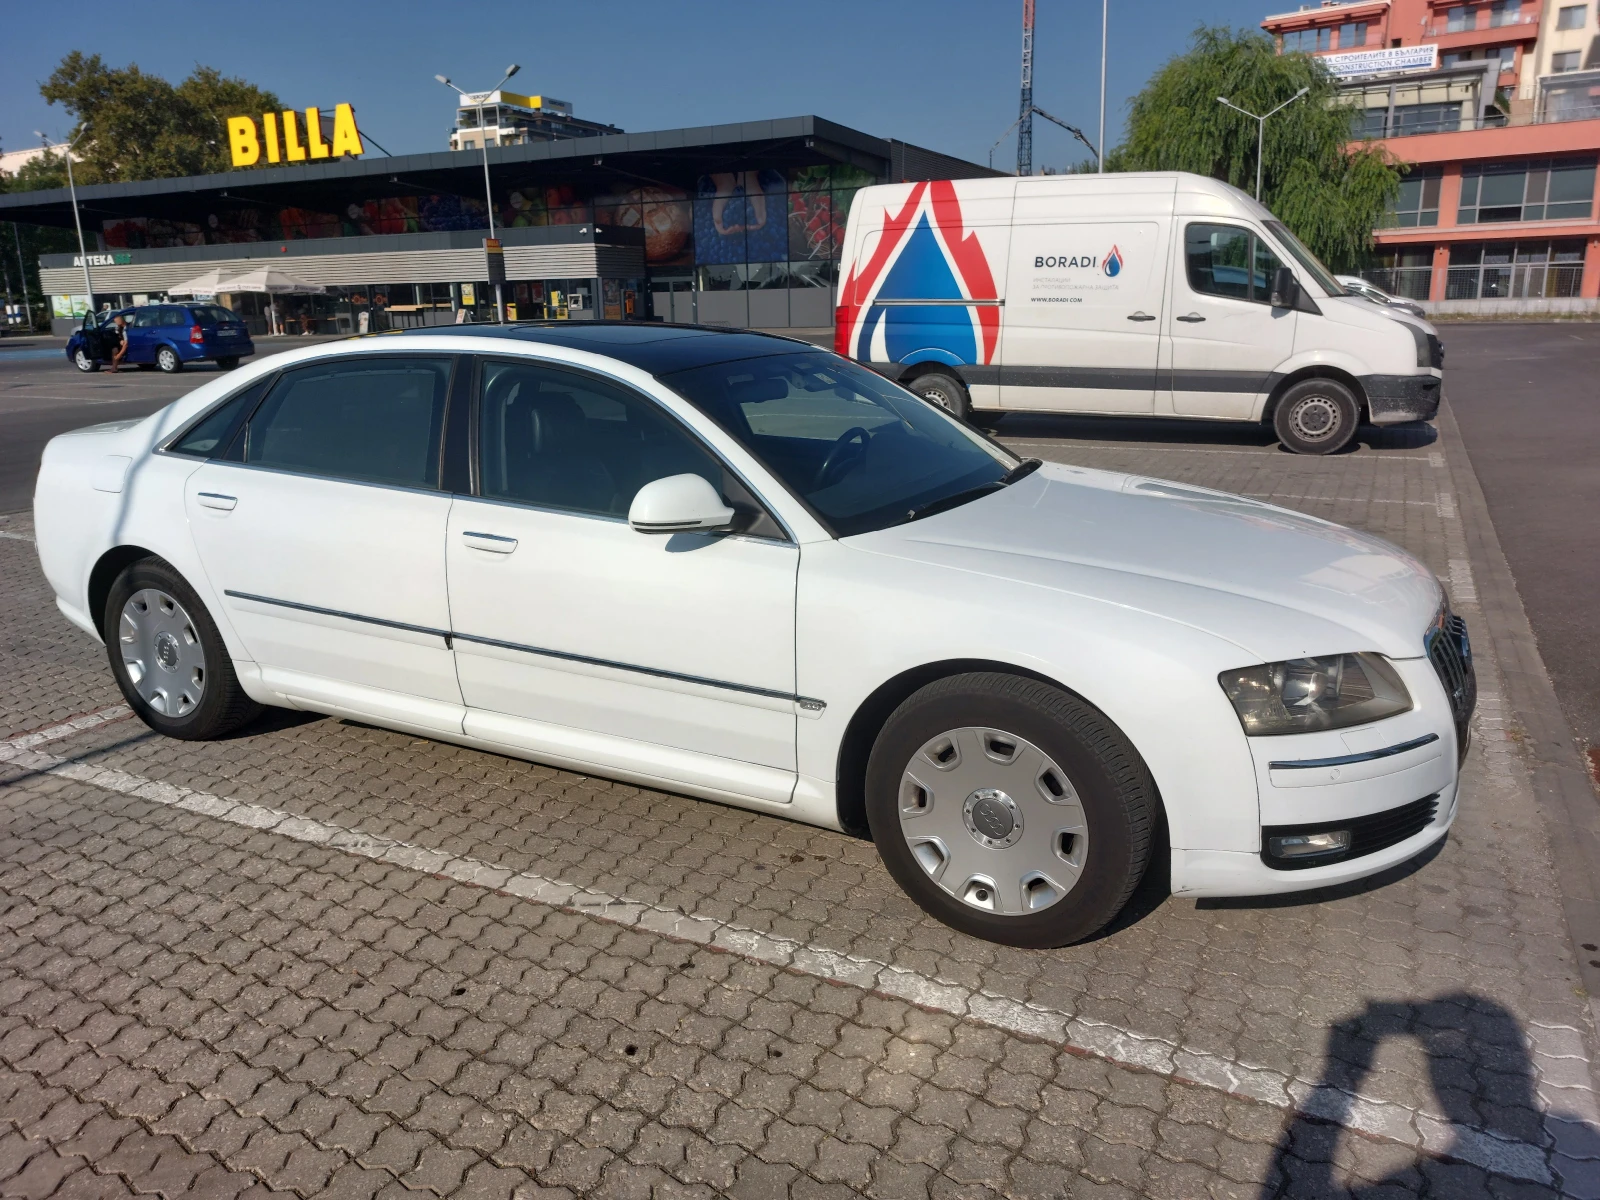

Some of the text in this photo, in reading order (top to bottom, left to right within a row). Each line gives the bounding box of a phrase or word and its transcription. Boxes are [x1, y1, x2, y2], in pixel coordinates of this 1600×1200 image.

[1334, 51, 1386, 63] СТРОИТЕЛИТЕ
[1395, 46, 1434, 57] БЪЛГАРИЯ
[1333, 60, 1392, 72] CONSTRUCTION
[1395, 56, 1433, 66] CHAMBER
[227, 103, 364, 167] BILLA
[1034, 256, 1097, 268] BORADI
